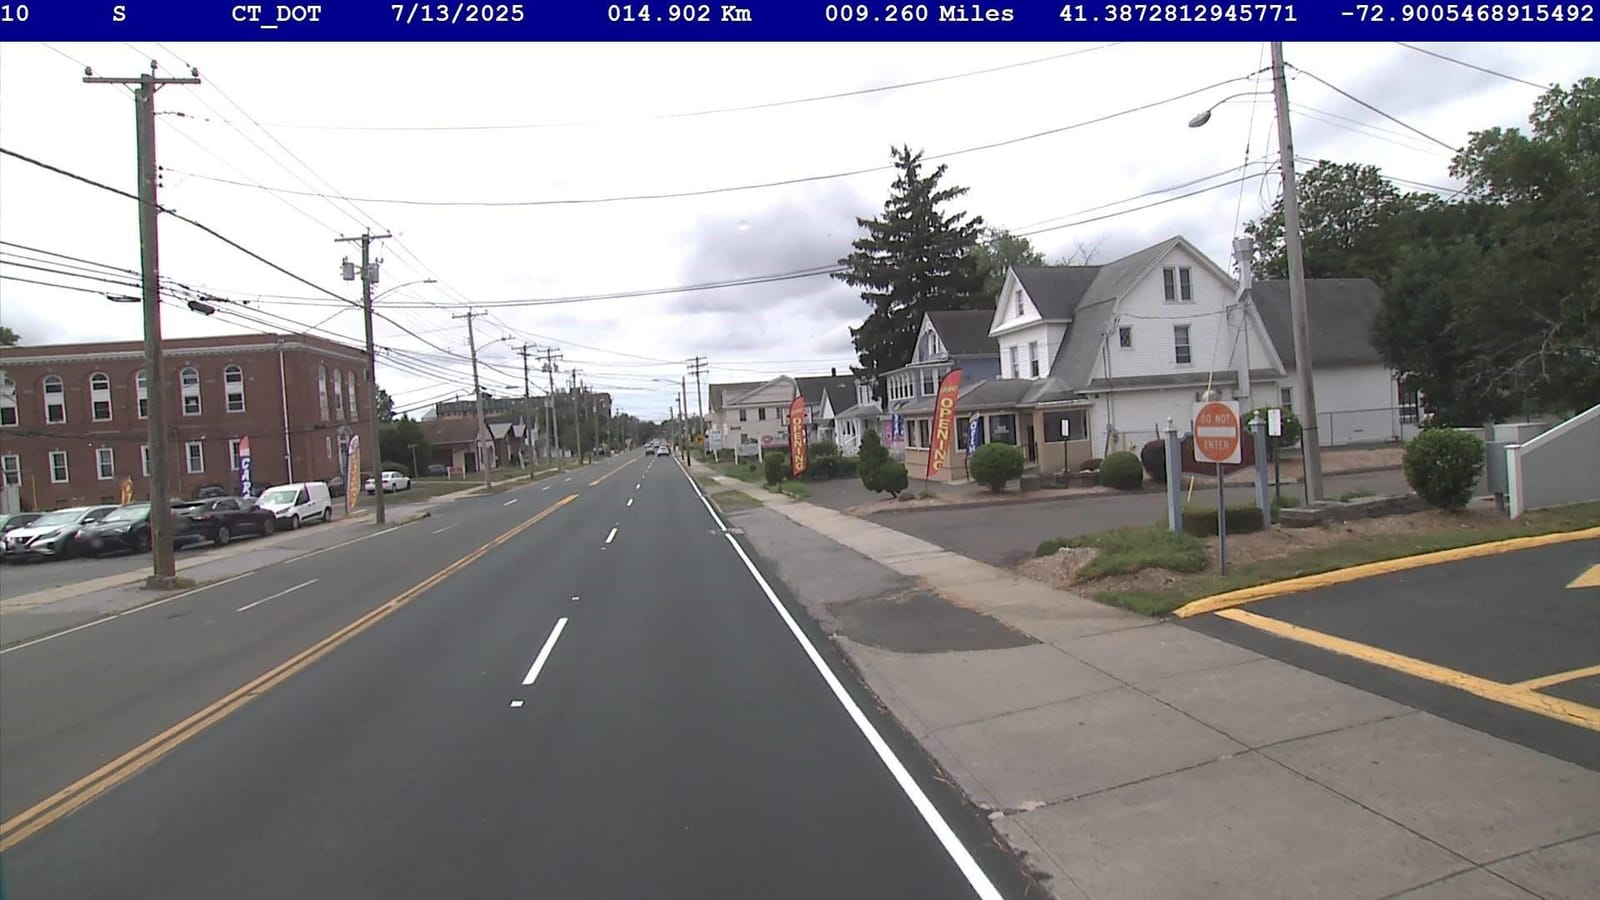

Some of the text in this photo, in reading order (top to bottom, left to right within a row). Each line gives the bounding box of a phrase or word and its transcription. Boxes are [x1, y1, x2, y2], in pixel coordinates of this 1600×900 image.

[933, 397, 954, 471] OPENING
[1200, 414, 1231, 424] DO NOT
[792, 417, 805, 471] OPENING
[1203, 439, 1230, 450] ENTER
